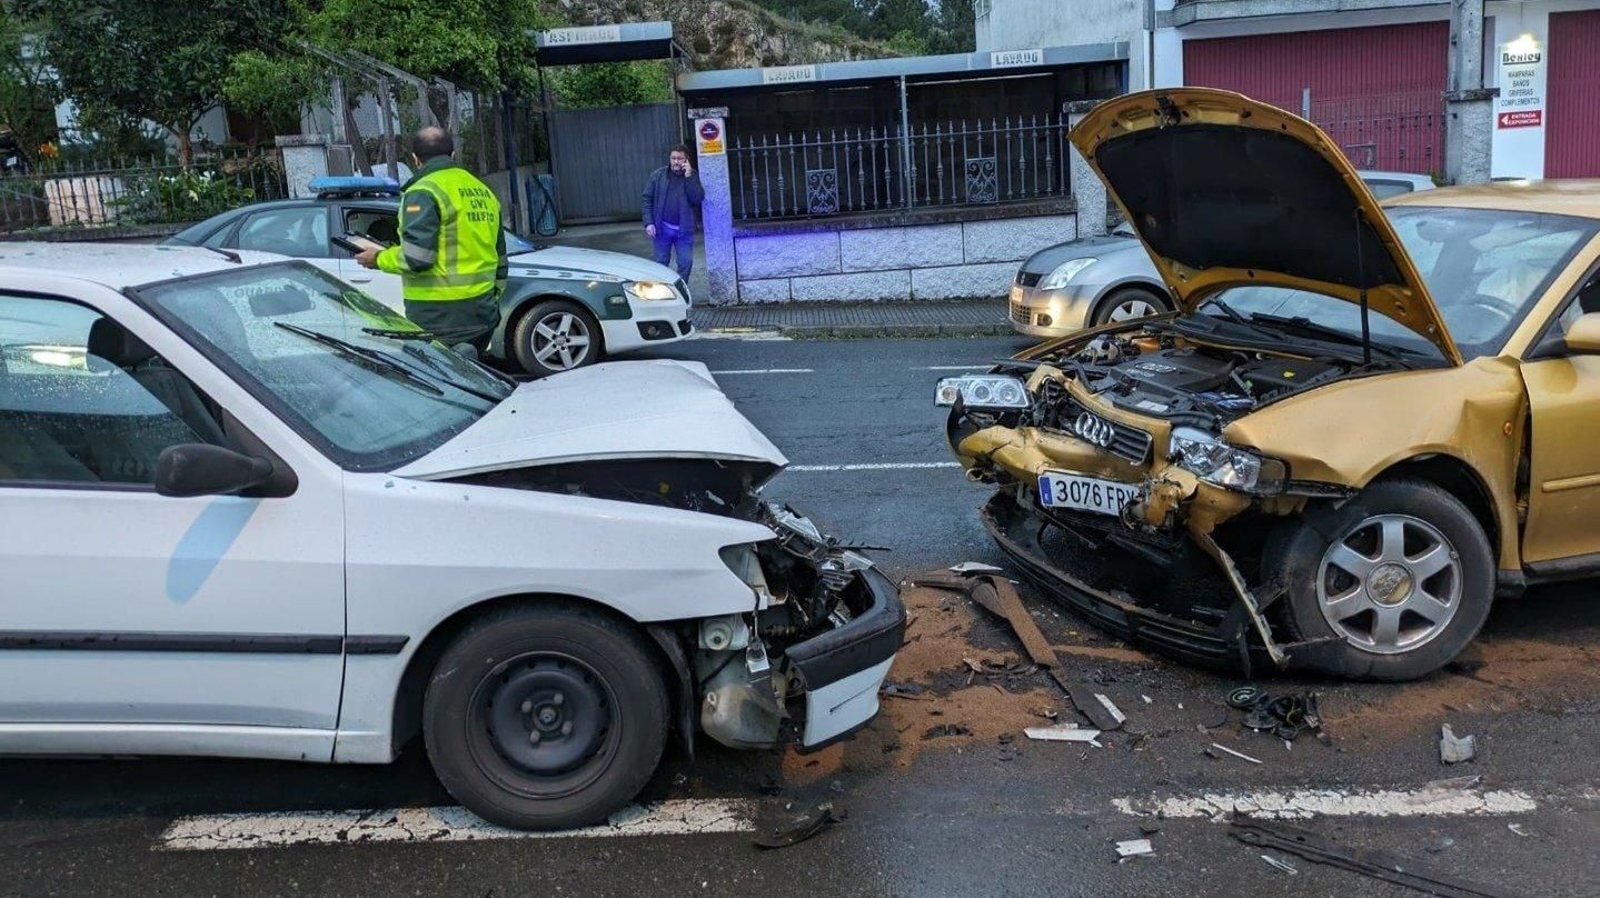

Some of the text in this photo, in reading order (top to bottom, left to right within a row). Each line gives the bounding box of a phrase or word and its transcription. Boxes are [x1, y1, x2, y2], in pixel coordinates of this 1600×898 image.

[995, 52, 1038, 65] LAVADO
[1508, 70, 1535, 78] MAMPARAS
[1500, 98, 1540, 106] COMPLEMENTOS
[458, 187, 491, 198] GUARDIA
[470, 199, 488, 209] CIVIL
[1055, 480, 1103, 507] 3076
